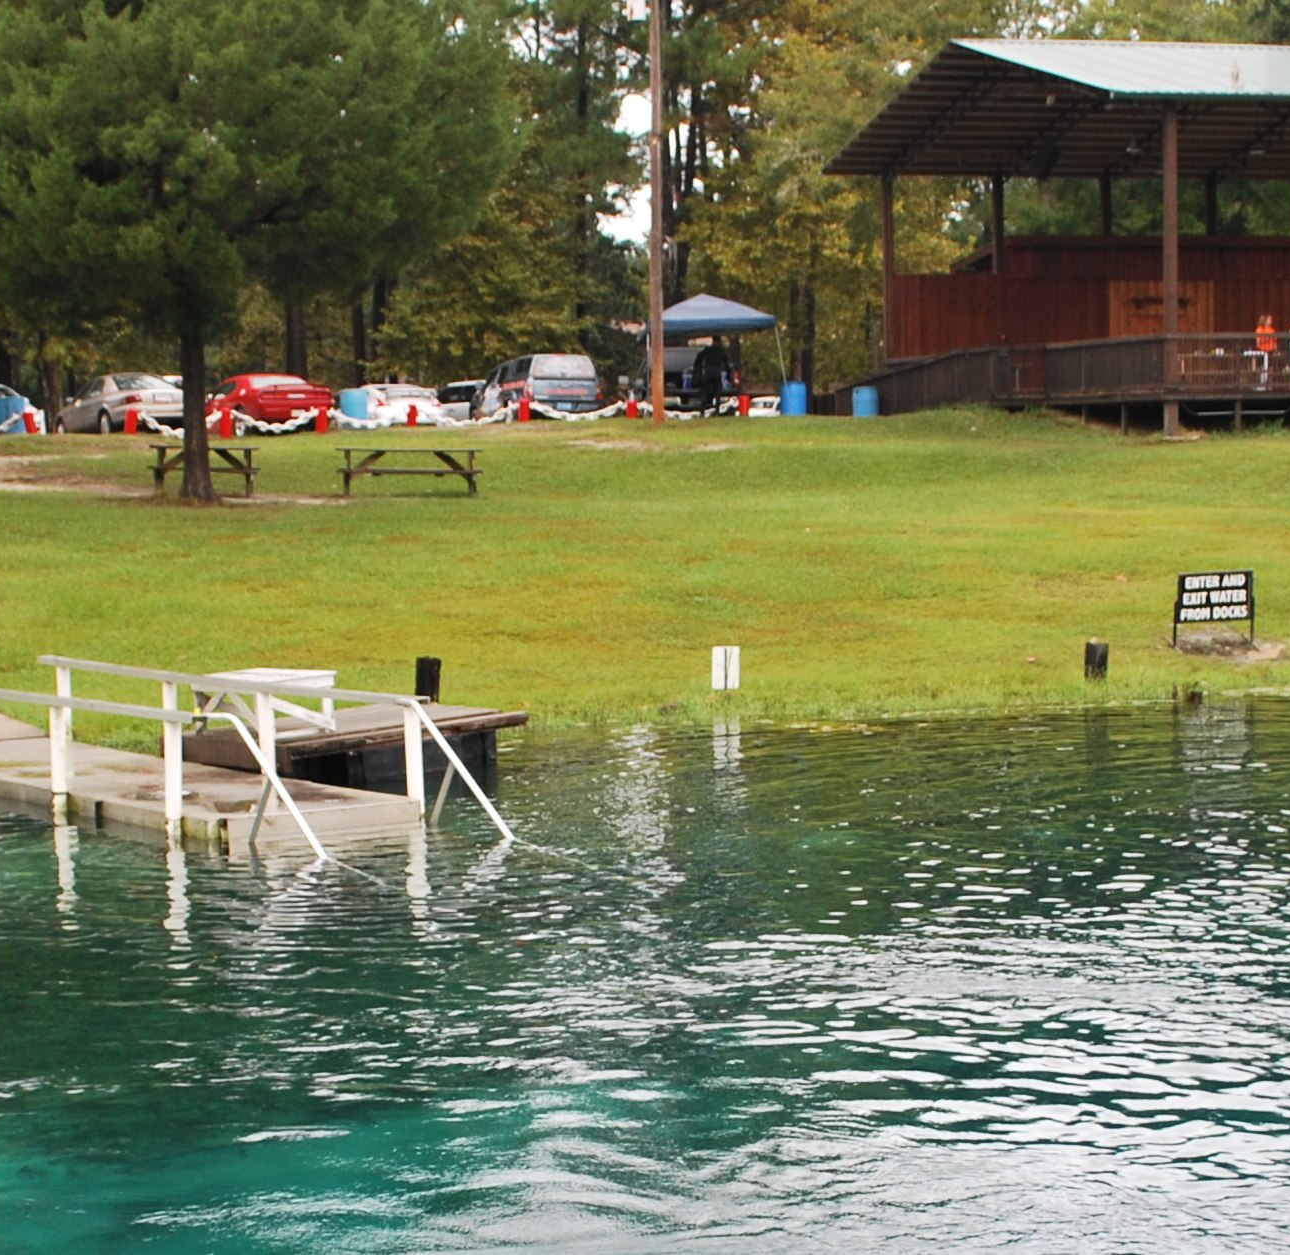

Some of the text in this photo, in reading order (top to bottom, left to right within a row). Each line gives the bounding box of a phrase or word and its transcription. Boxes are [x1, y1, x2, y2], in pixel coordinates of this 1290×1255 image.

[1185, 574, 1246, 589] ENTER AND
[1183, 589, 1246, 605] EXIT WATER
[1180, 605, 1248, 621] FROM DOCKS
